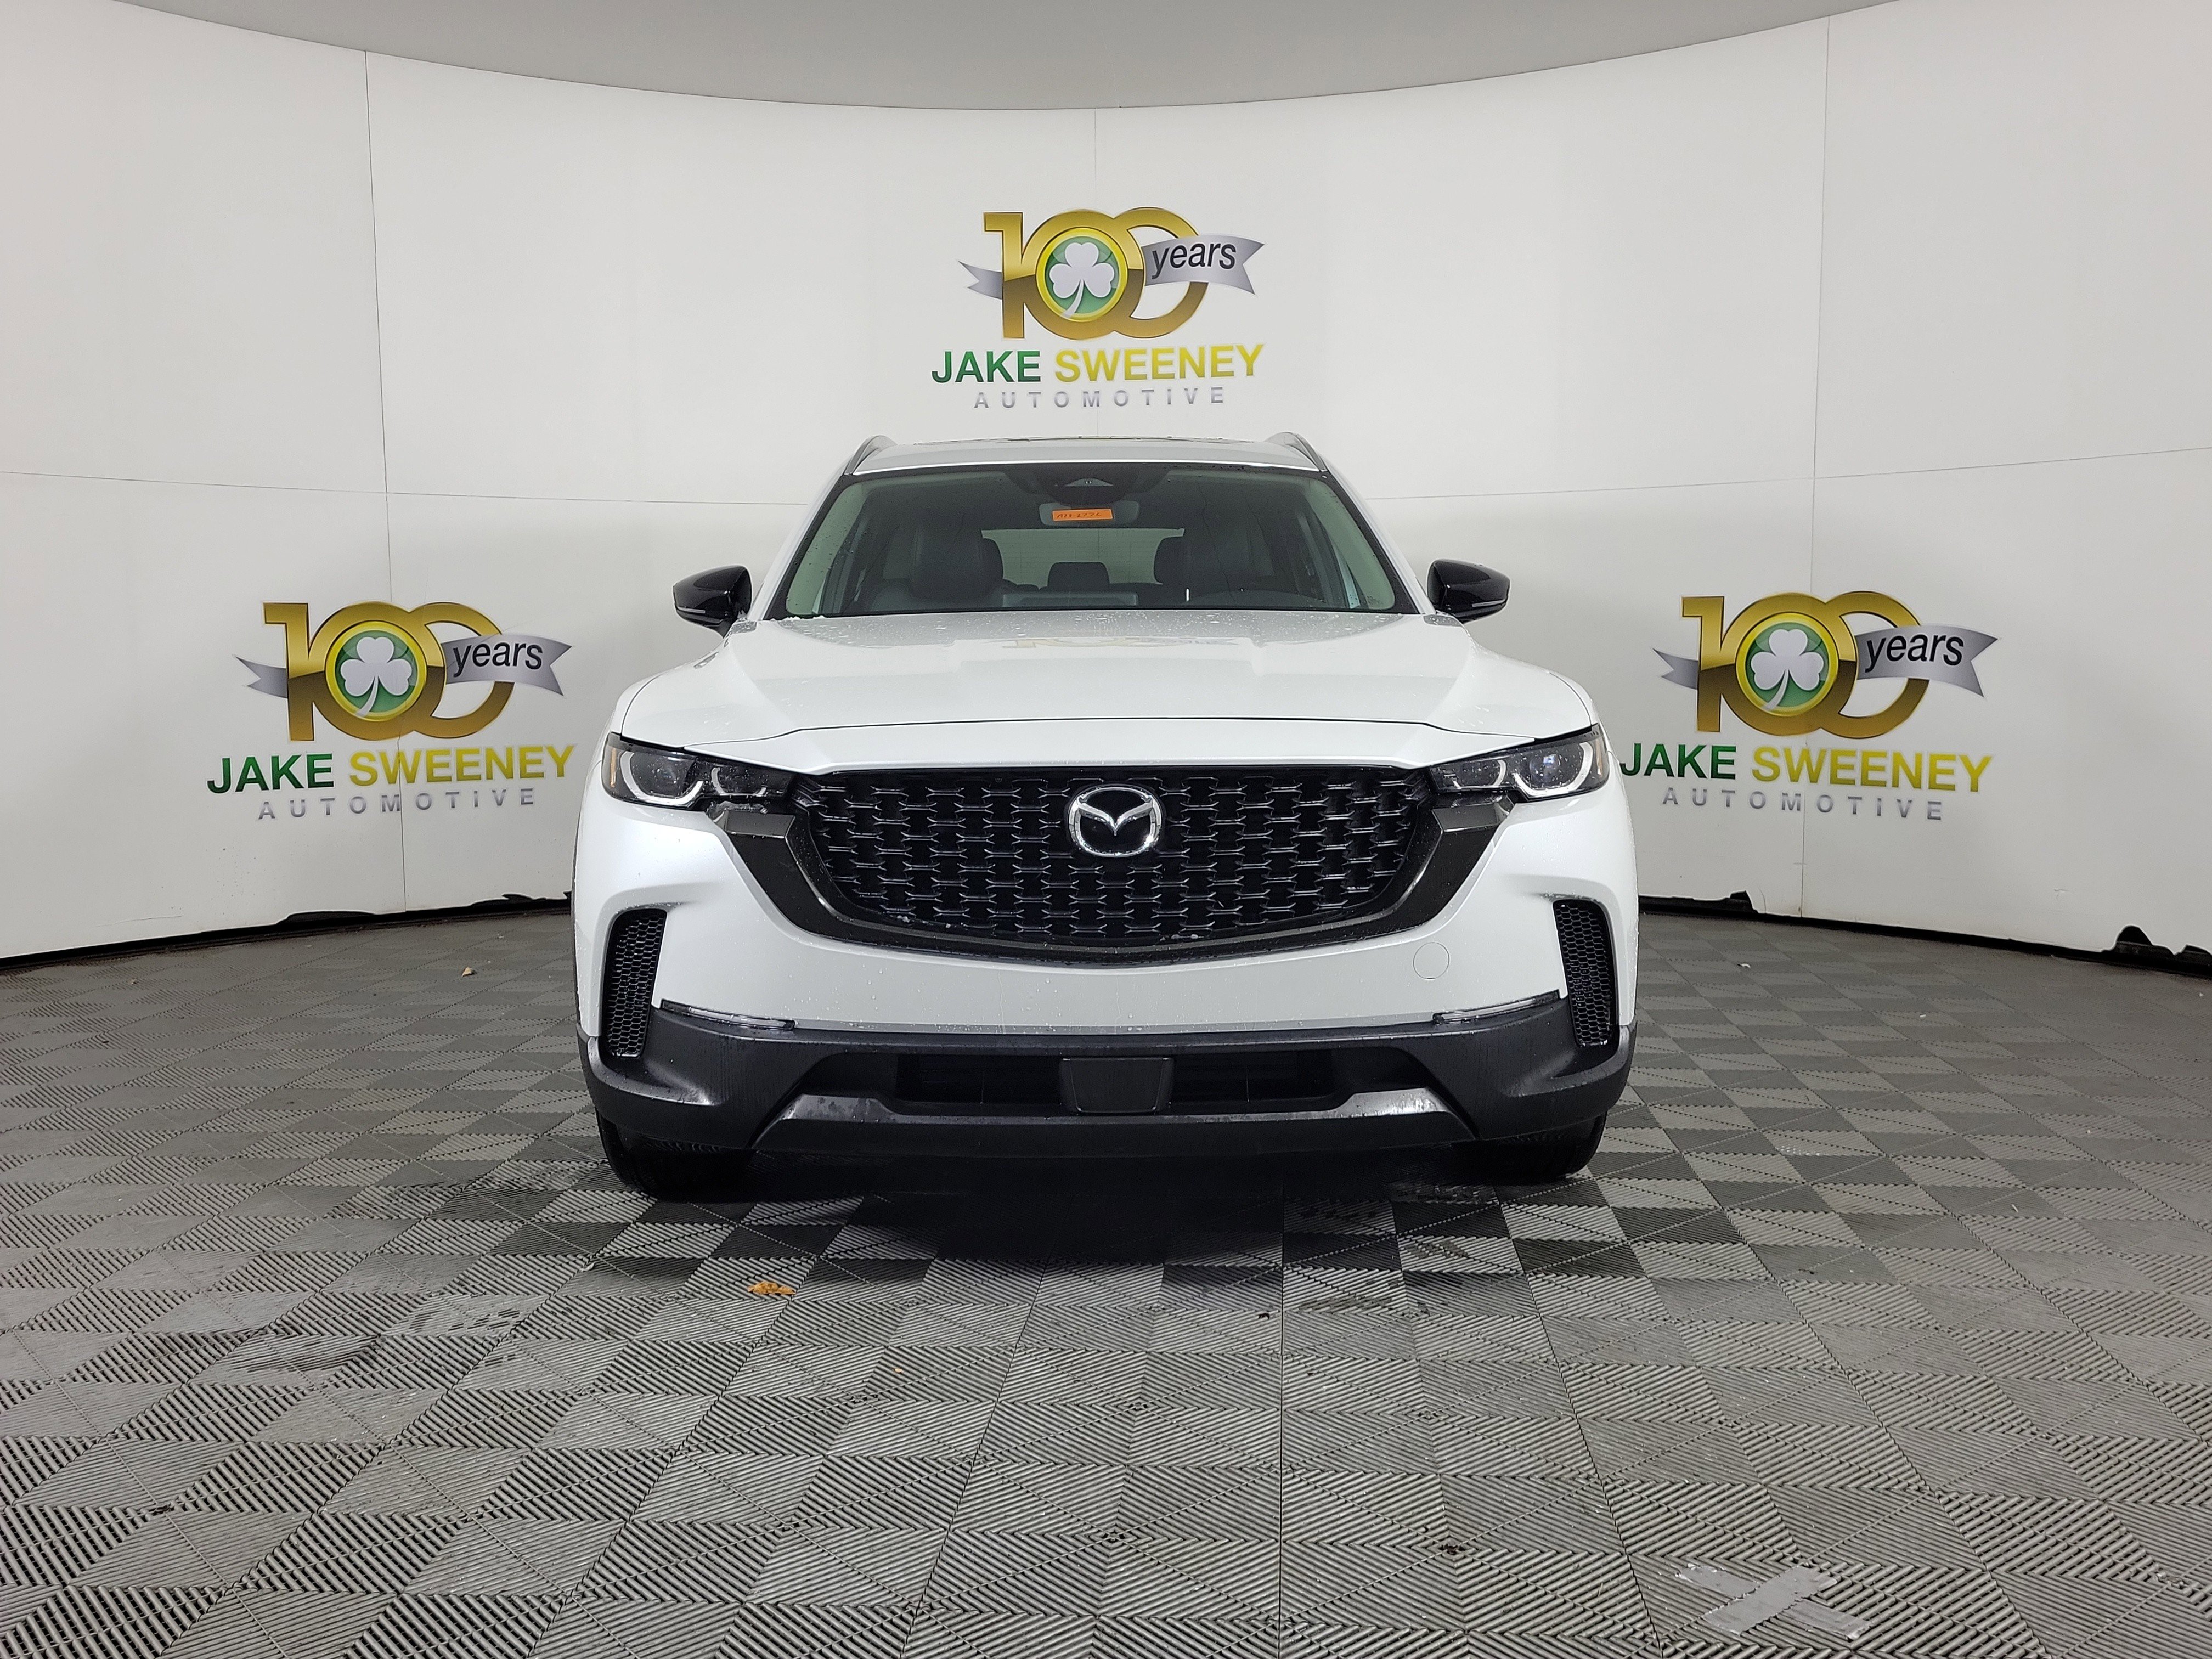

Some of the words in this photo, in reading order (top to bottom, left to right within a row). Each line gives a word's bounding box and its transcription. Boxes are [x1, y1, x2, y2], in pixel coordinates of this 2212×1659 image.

[984, 207, 1207, 340] 100
[1152, 243, 1237, 279] years
[932, 351, 1041, 383] JAKE
[1054, 345, 1263, 383] SWEENEY
[974, 387, 1224, 409] AUTOMOTIVE
[263, 601, 515, 741] 100
[453, 641, 543, 677] years
[1681, 590, 1929, 739] 100
[1864, 634, 1964, 673] years
[207, 753, 334, 794] JAKE
[349, 745, 574, 786] SWEENEY
[1620, 743, 1736, 779] JAKE
[1751, 746, 1991, 792] SWEENEY
[258, 788, 534, 820] AUTOMOTIVE
[1662, 787, 1942, 820] AUTOMOTIVE
